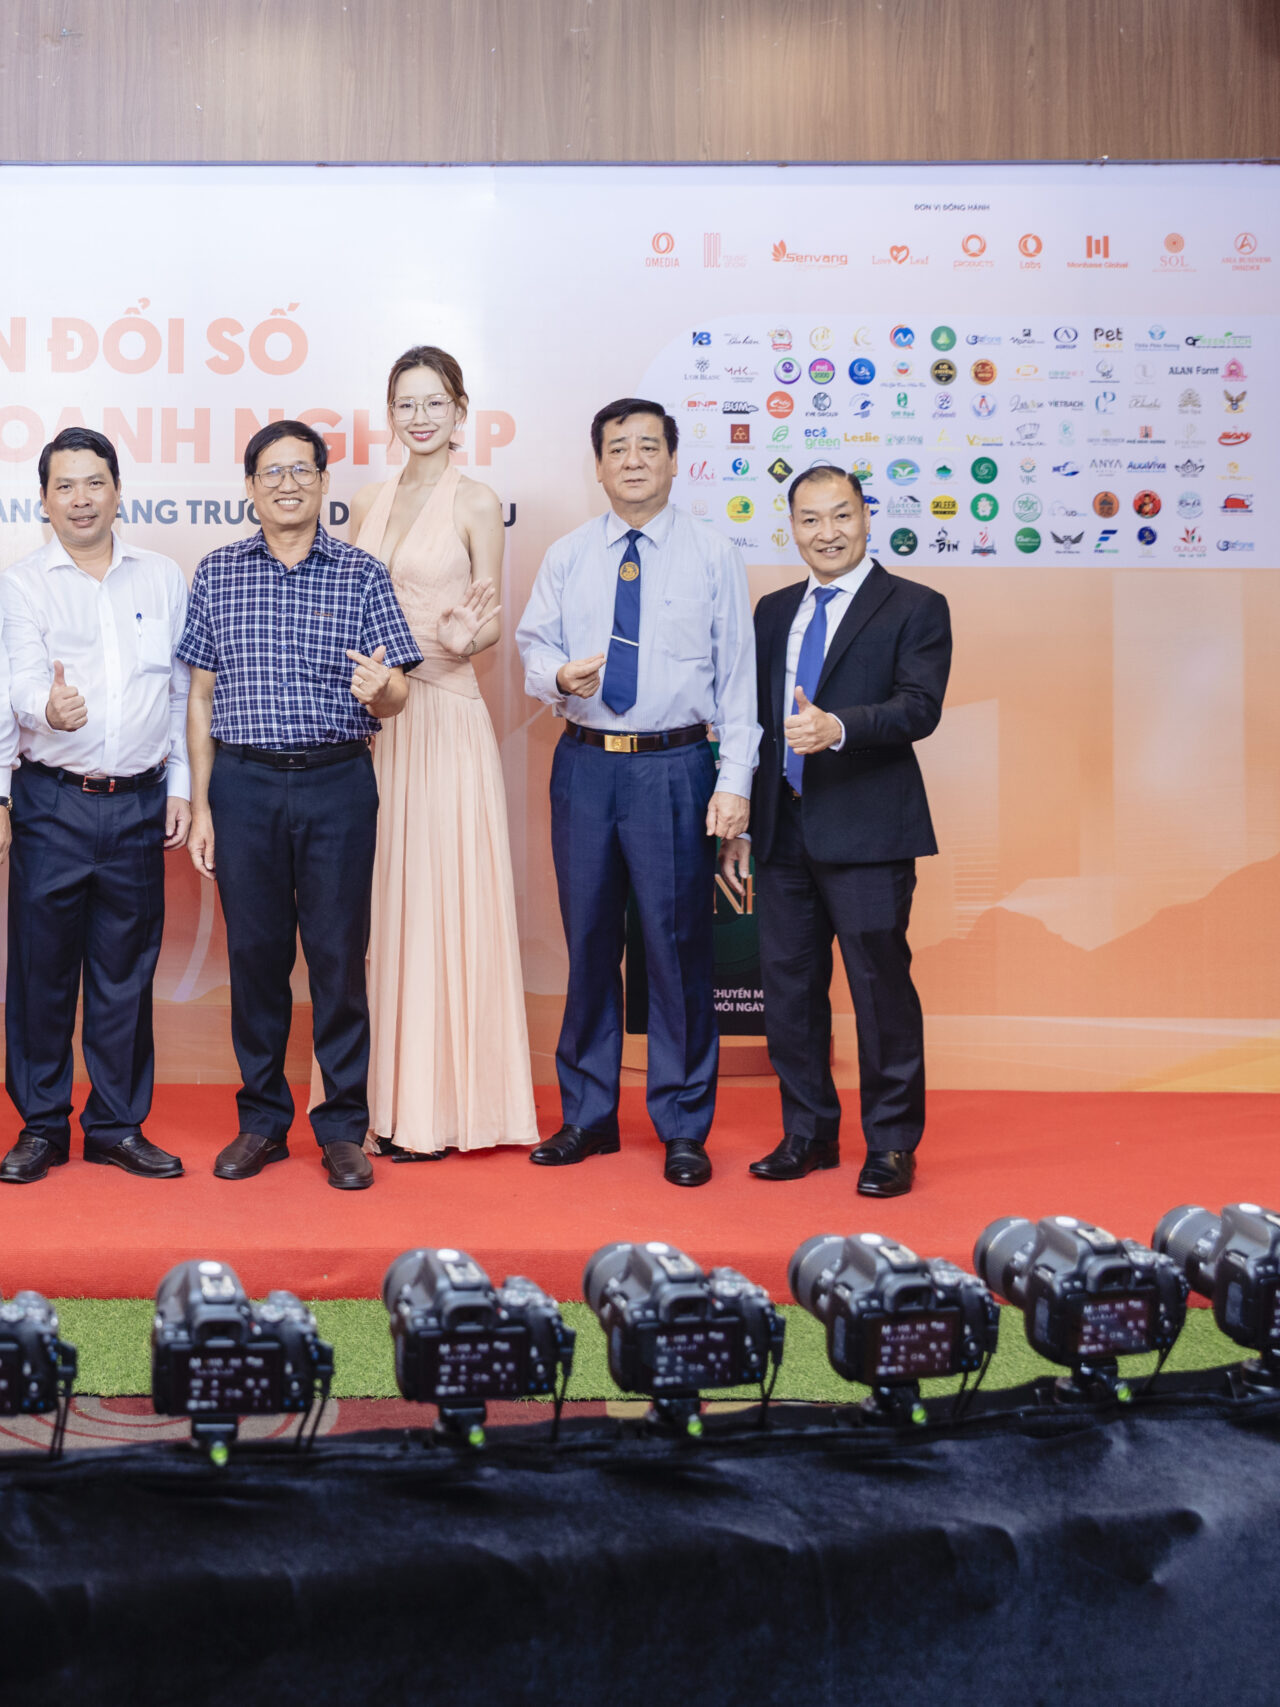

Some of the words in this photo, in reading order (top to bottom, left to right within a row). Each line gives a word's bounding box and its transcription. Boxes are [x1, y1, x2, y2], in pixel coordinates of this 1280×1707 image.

[1159, 255, 1190, 269] SOL
[47, 296, 185, 376] ĐỔI
[205, 301, 310, 376] SỐ
[1093, 327, 1124, 342] Pet
[804, 437, 841, 450] green
